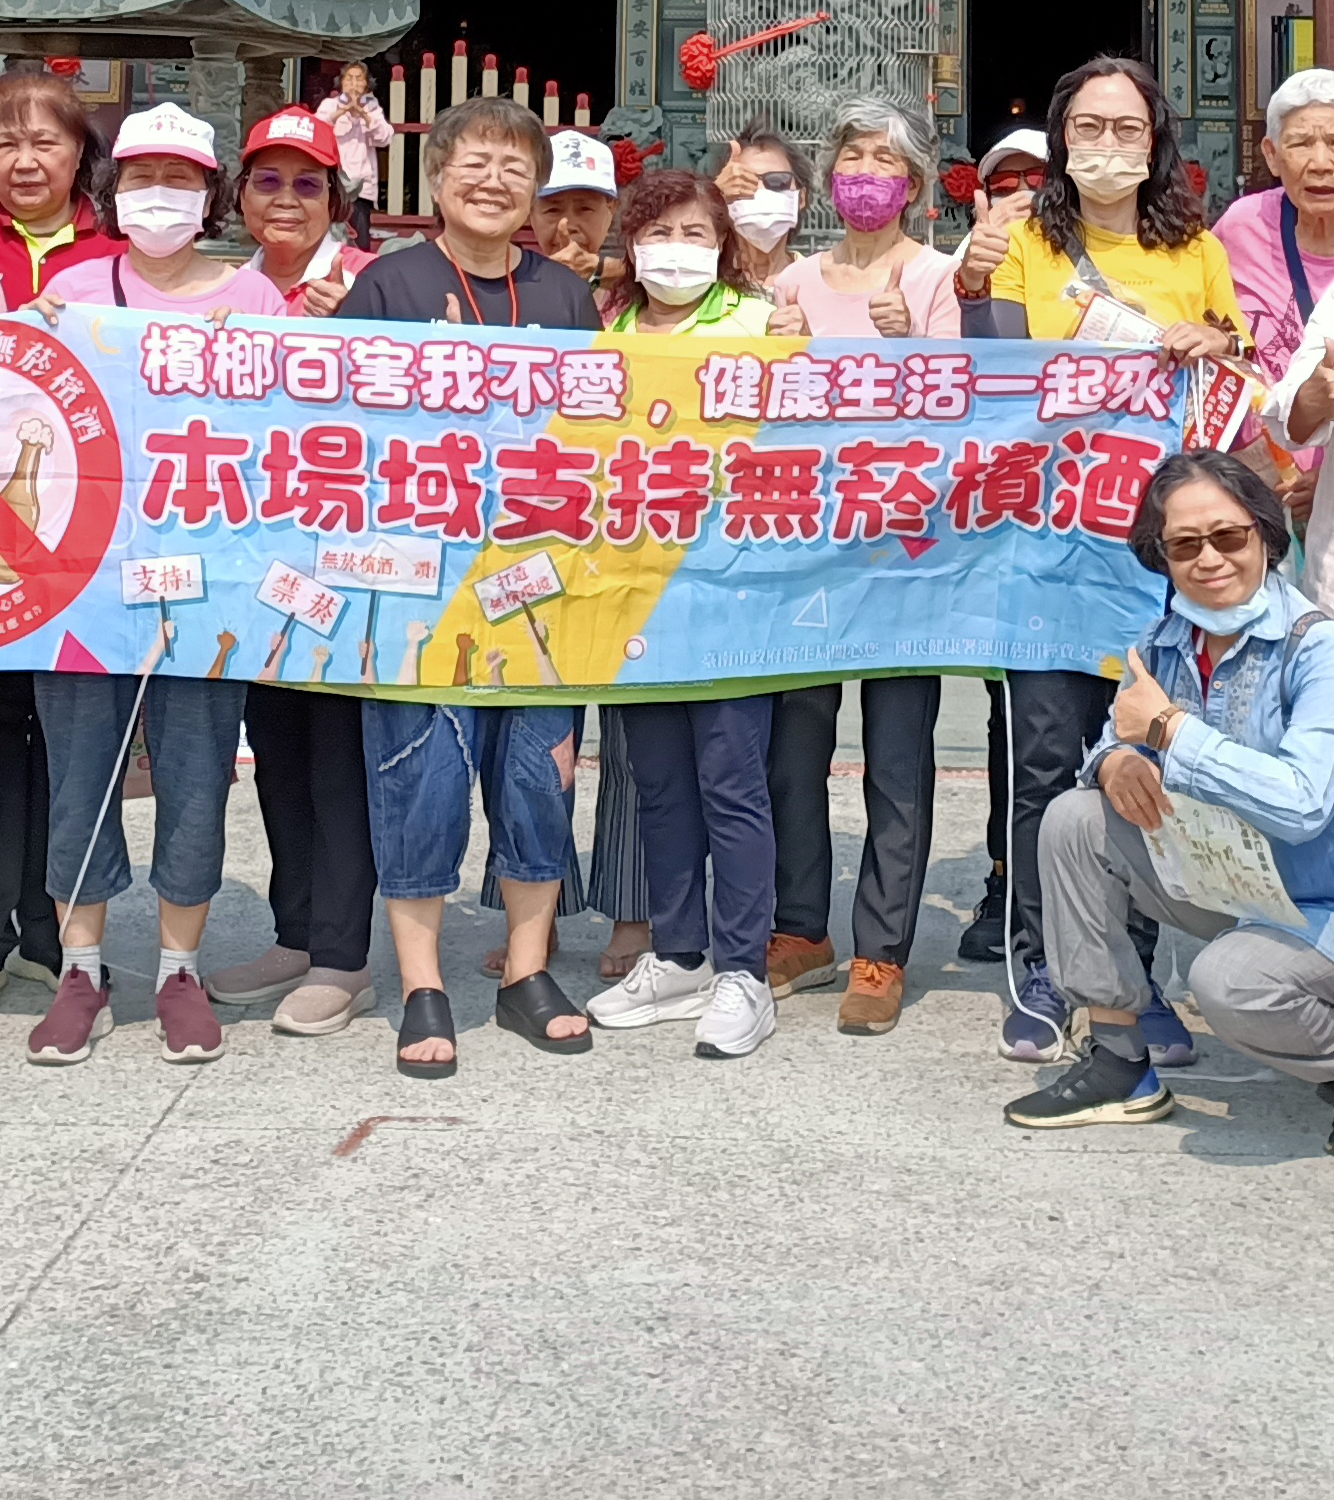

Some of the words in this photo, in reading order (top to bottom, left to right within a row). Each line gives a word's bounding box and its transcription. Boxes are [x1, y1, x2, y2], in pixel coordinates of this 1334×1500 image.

[141, 322, 1175, 430] 檳榔百害我不愛，健康生活一起來
[140, 415, 1164, 546] 本場域支持無菸檳酒
